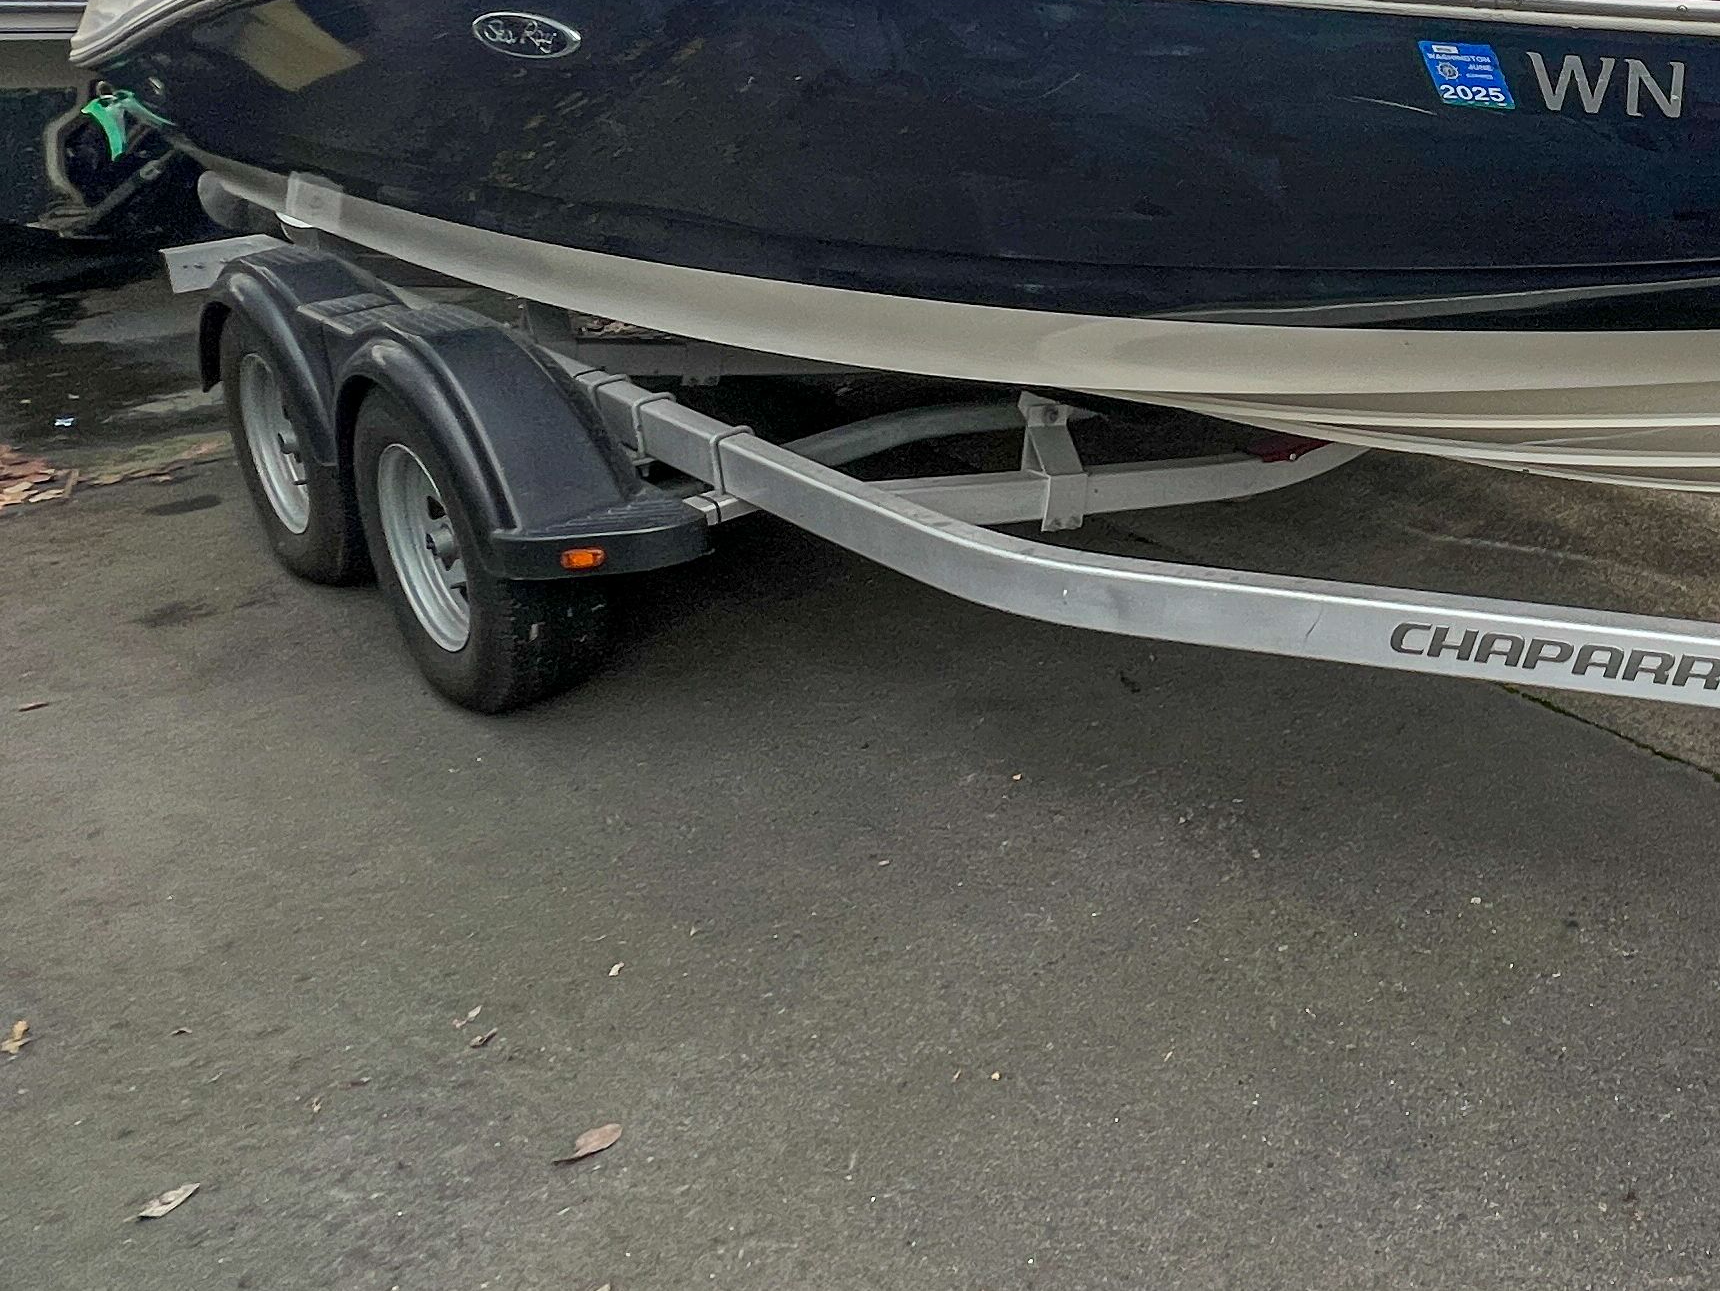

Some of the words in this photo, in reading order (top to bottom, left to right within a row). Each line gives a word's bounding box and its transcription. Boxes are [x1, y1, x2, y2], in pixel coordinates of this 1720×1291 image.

[484, 19, 517, 44] Sea
[1440, 84, 1505, 103] 2025
[1527, 52, 1684, 117] WN
